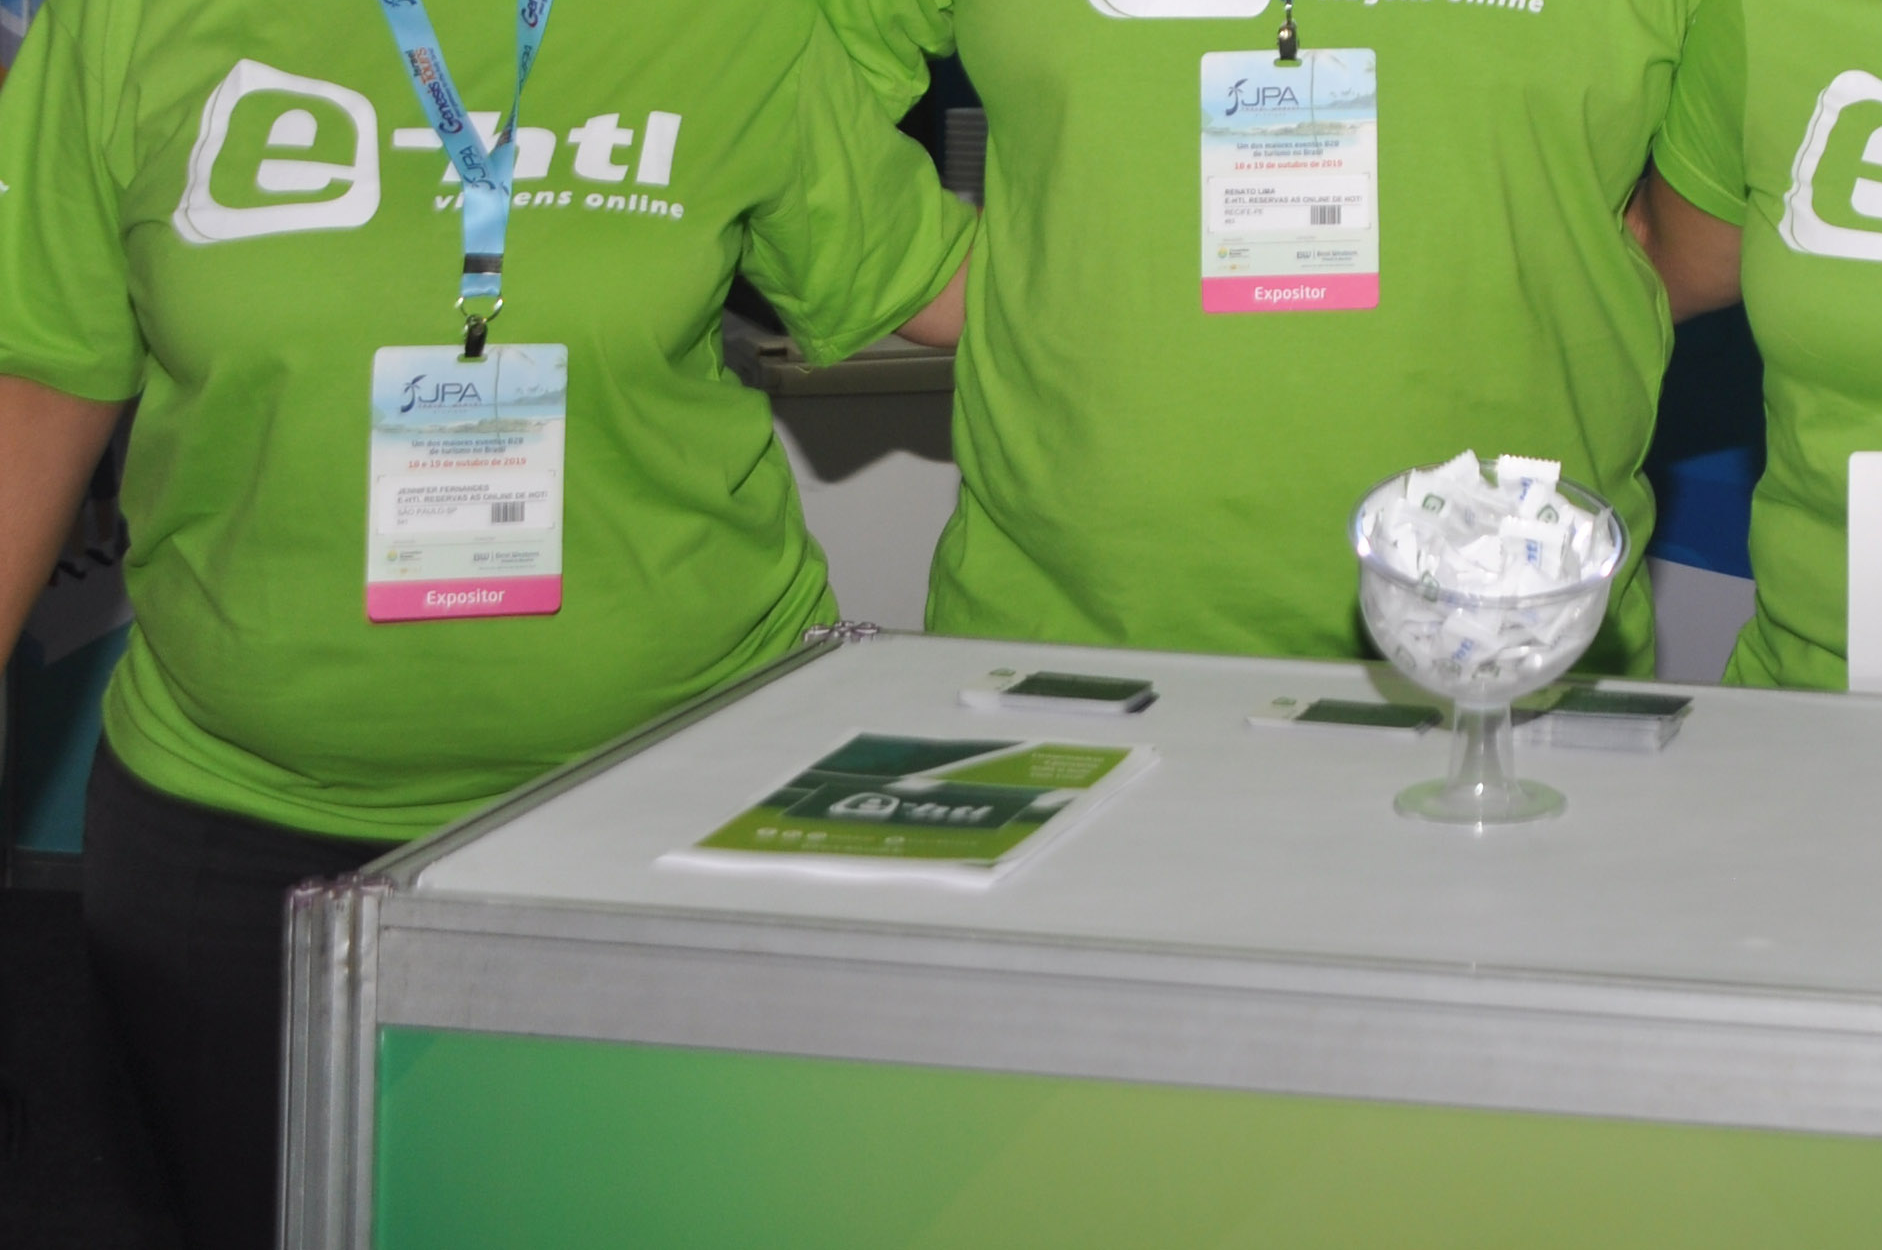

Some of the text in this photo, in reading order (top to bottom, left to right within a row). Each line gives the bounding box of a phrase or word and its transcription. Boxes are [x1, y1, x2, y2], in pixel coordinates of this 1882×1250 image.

[1240, 85, 1299, 107] JPA
[434, 190, 685, 219] viens online
[1254, 285, 1327, 303] Expositor
[418, 382, 482, 403] JPA
[426, 589, 505, 607] Expositor
